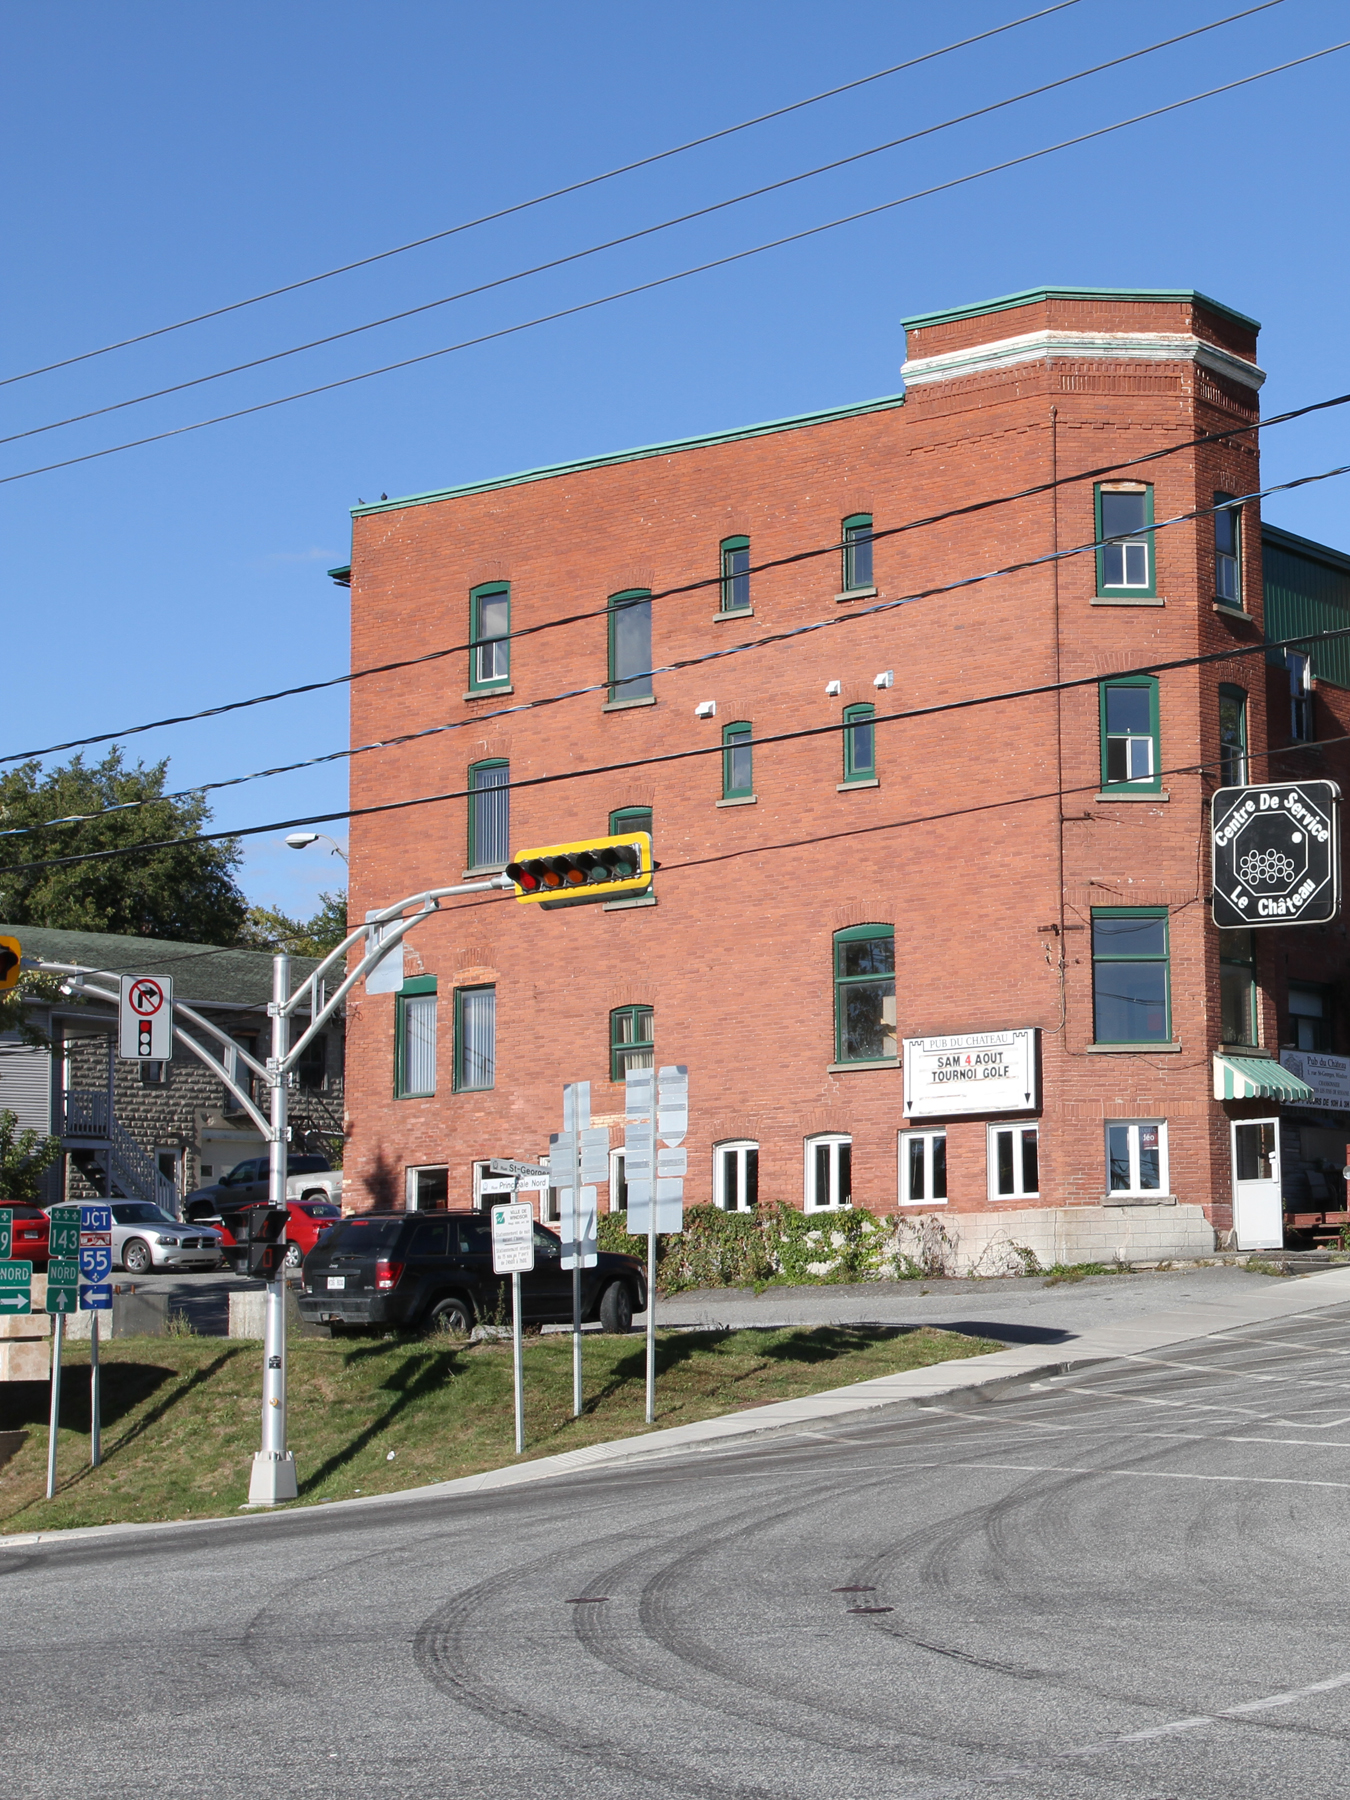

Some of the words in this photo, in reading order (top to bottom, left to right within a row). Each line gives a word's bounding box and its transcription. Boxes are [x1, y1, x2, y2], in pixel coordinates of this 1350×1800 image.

[1215, 800, 1256, 847] Centre
[1260, 793, 1280, 810] De
[1284, 792, 1329, 843] Service
[1230, 885, 1249, 909] Le
[1258, 878, 1316, 916] Château
[930, 1039, 947, 1049] PUB
[950, 1037, 963, 1047] DU
[966, 1034, 1008, 1046] CHATEAU
[937, 1055, 960, 1068] SAM
[965, 1054, 972, 1066] 4
[975, 1052, 1003, 1065] AOUT
[1307, 1056, 1319, 1066] Pub
[1319, 1057, 1327, 1066] du
[932, 1068, 977, 1082] TOURNOI
[983, 1065, 1009, 1078] GOLF
[499, 1180, 529, 1190] Princpale
[531, 1178, 546, 1187] Nord
[82, 1211, 108, 1226] JCT
[51, 1228, 78, 1250] 143
[83, 1250, 108, 1271] 55
[0, 1267, 29, 1280] NORD
[50, 1266, 76, 1280] NORD
